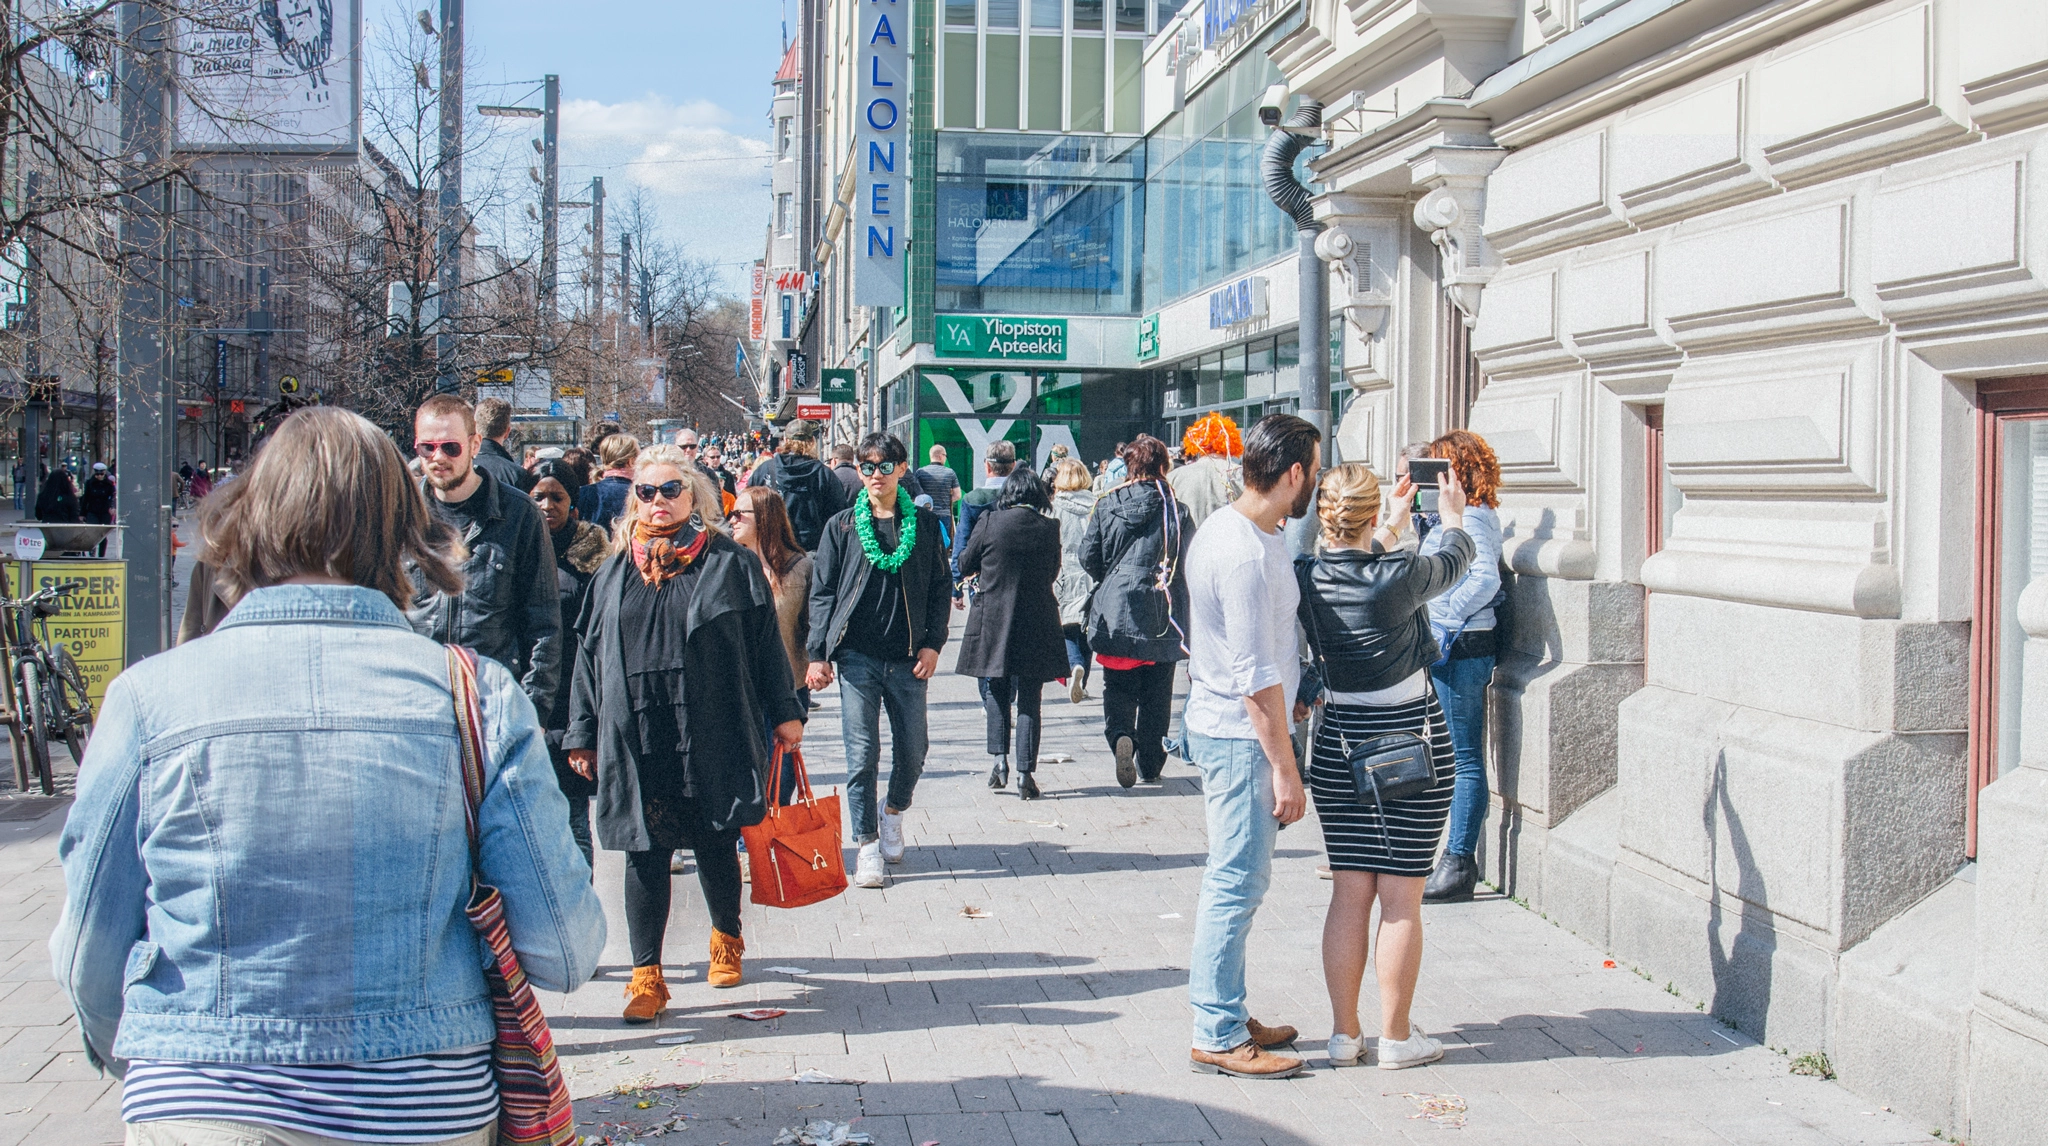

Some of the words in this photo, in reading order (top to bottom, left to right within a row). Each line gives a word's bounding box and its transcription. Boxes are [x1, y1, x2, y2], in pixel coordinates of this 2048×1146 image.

[867, 0, 898, 258] ALONEN
[948, 217, 1007, 228] HALONEN
[752, 269, 763, 295] Koski
[775, 272, 805, 291] H&M
[947, 323, 971, 346] YA
[982, 318, 1062, 339] Yliopiston
[988, 337, 1062, 357] Apteekki
[40, 576, 120, 595] SUPER-
[51, 595, 120, 610] ALVALLA
[54, 627, 110, 639] PARTURI
